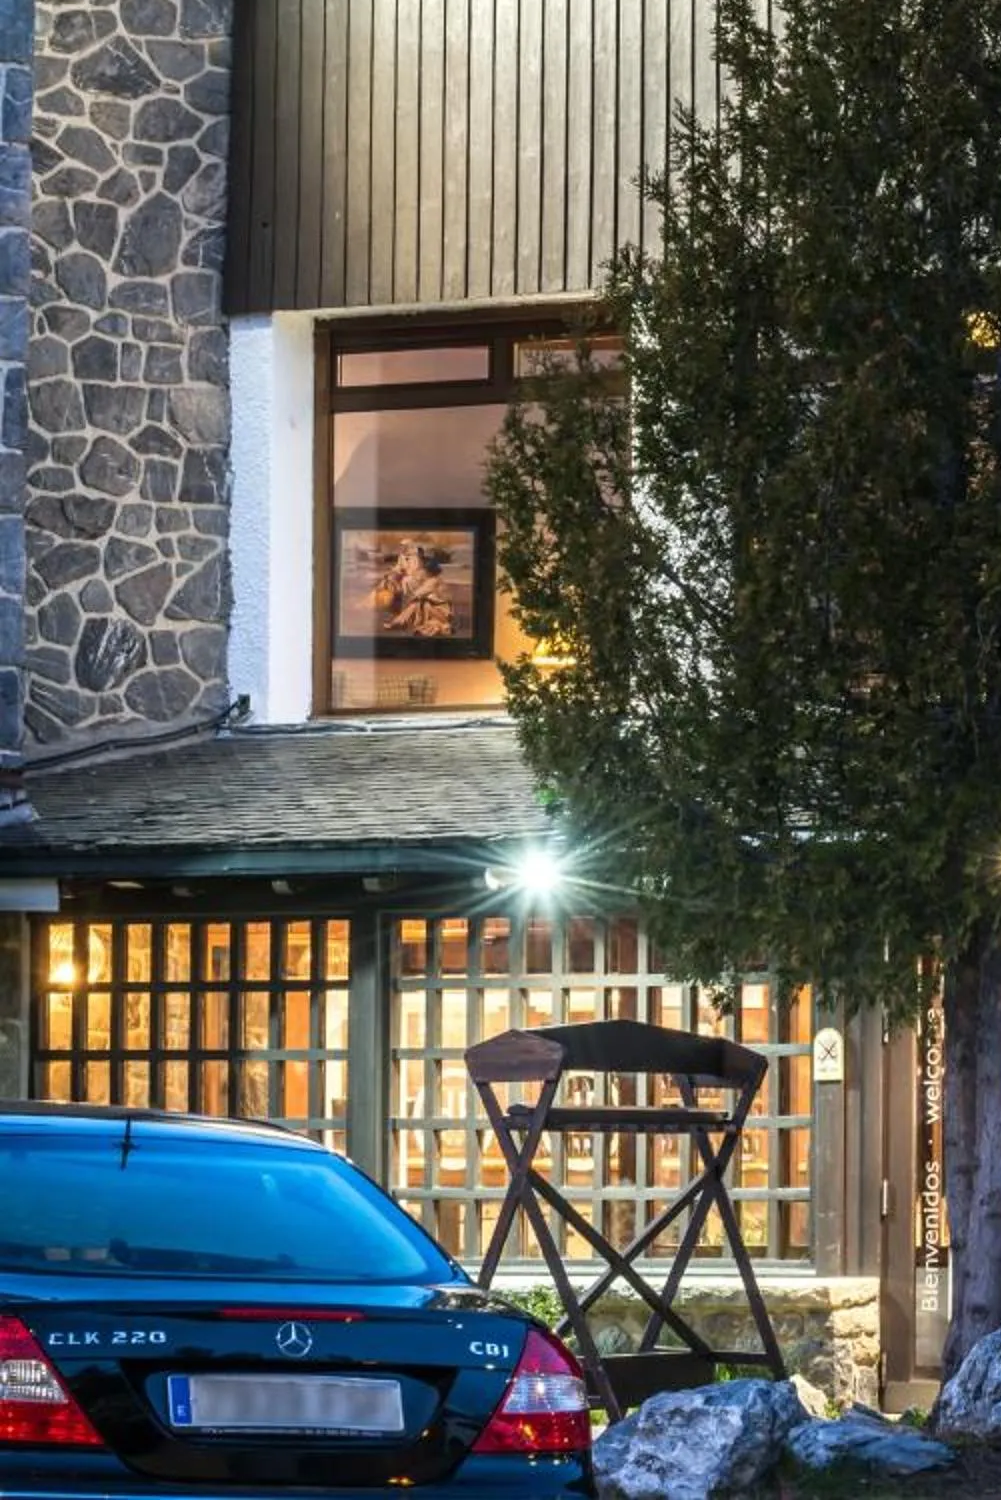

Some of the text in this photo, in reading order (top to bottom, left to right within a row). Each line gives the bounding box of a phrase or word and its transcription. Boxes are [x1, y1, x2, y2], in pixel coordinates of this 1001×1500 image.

[922, 1008, 941, 1311] Bienvenidos welcoe
[48, 1331, 167, 1345] CLK 220
[470, 1341, 509, 1358] CDI
